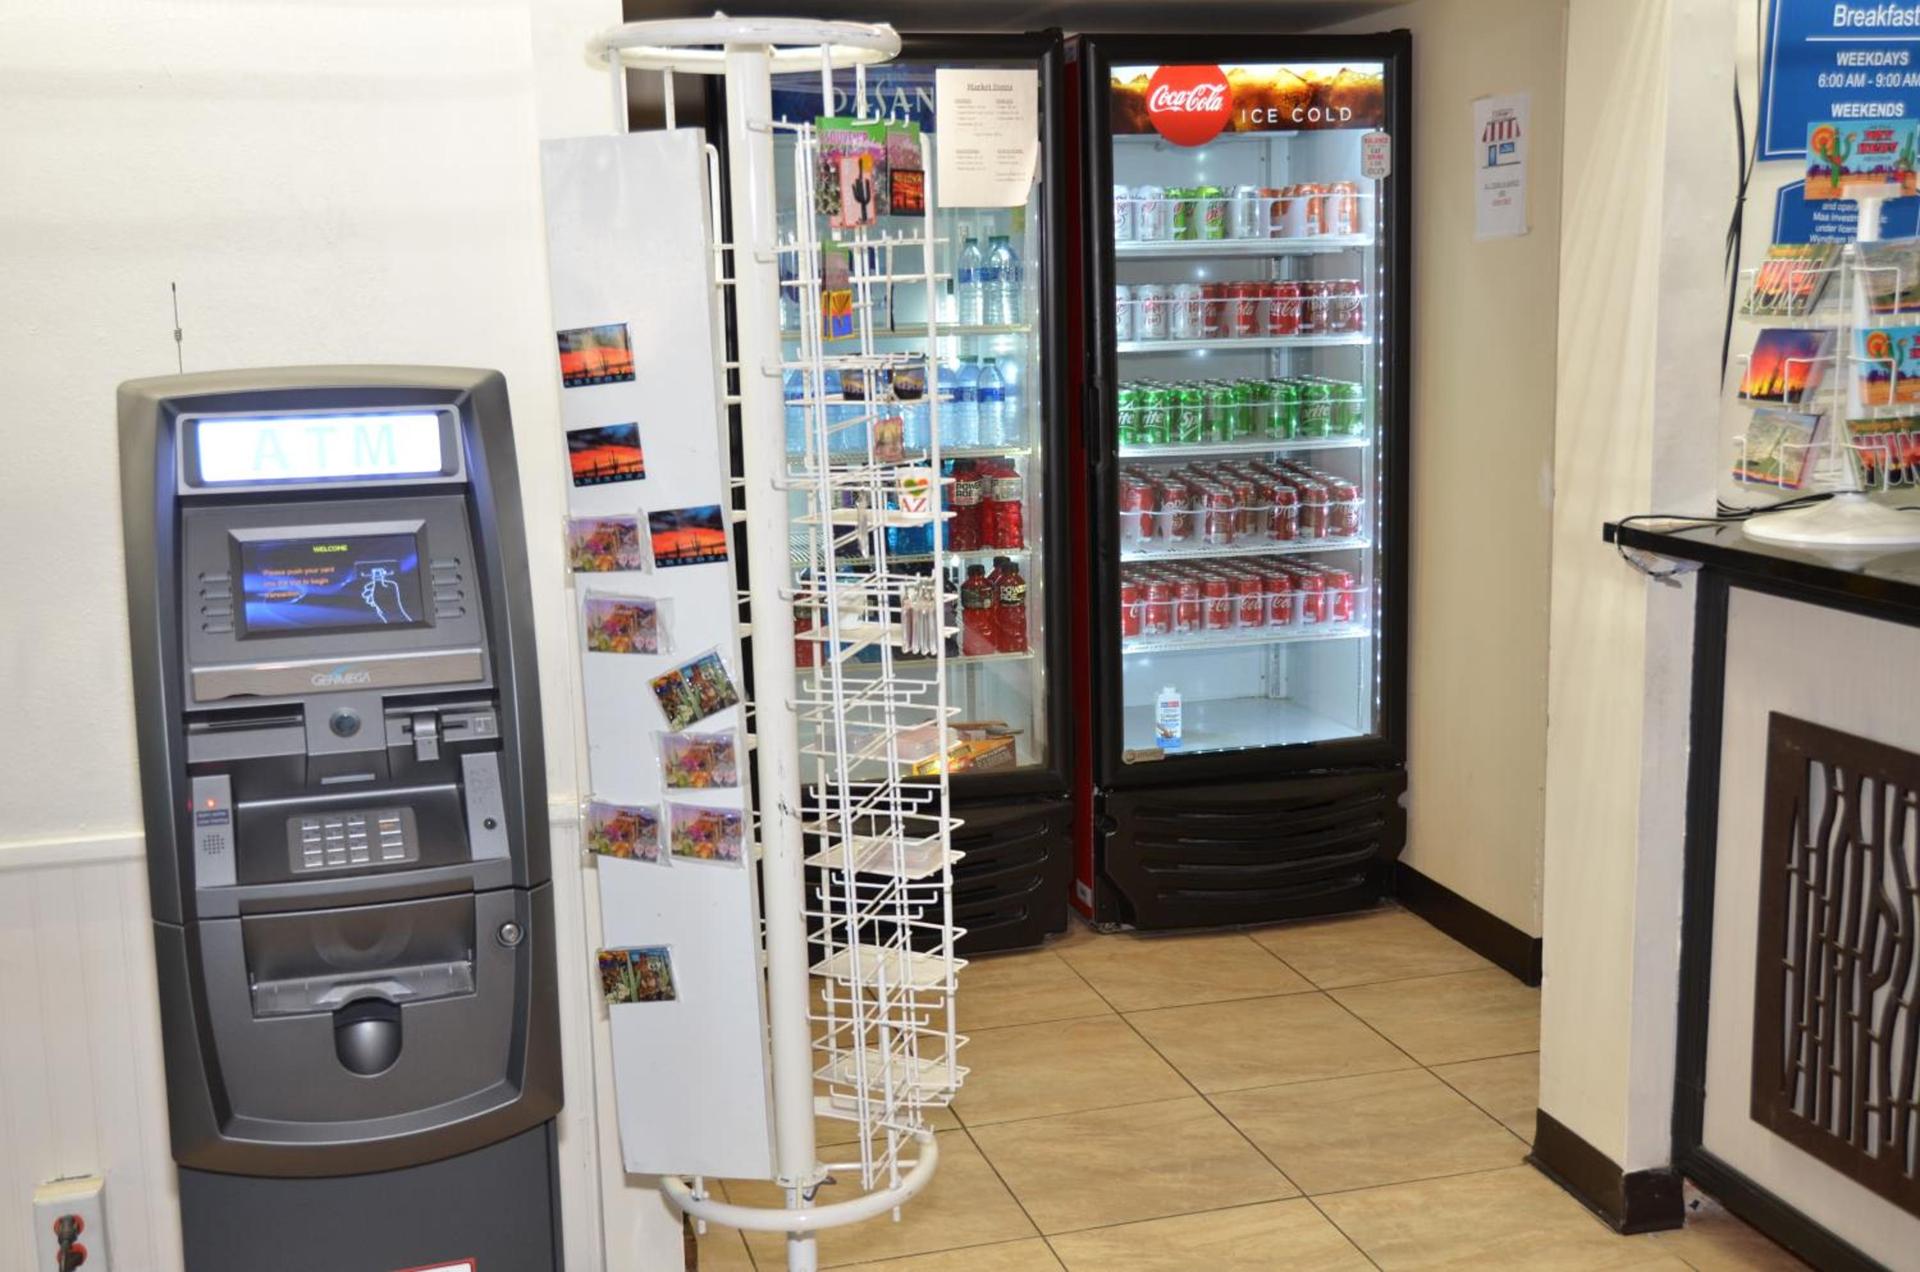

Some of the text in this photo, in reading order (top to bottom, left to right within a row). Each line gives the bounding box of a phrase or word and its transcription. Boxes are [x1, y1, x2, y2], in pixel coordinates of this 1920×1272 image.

[1833, 4, 1920, 27] Breakfast
[1836, 52, 1909, 66] WEEKDAYS
[1818, 73, 1843, 88] 6:00
[1845, 73, 1865, 88] AM
[1875, 73, 1901, 88] 9:00
[830, 79, 936, 118] DSAN
[1150, 83, 1227, 113] Coca-Cola
[1241, 107, 1352, 123] ICE COLD
[1831, 103, 1905, 118] WEEKENDS
[254, 424, 398, 471] ATM
[312, 544, 348, 553] WELCOME
